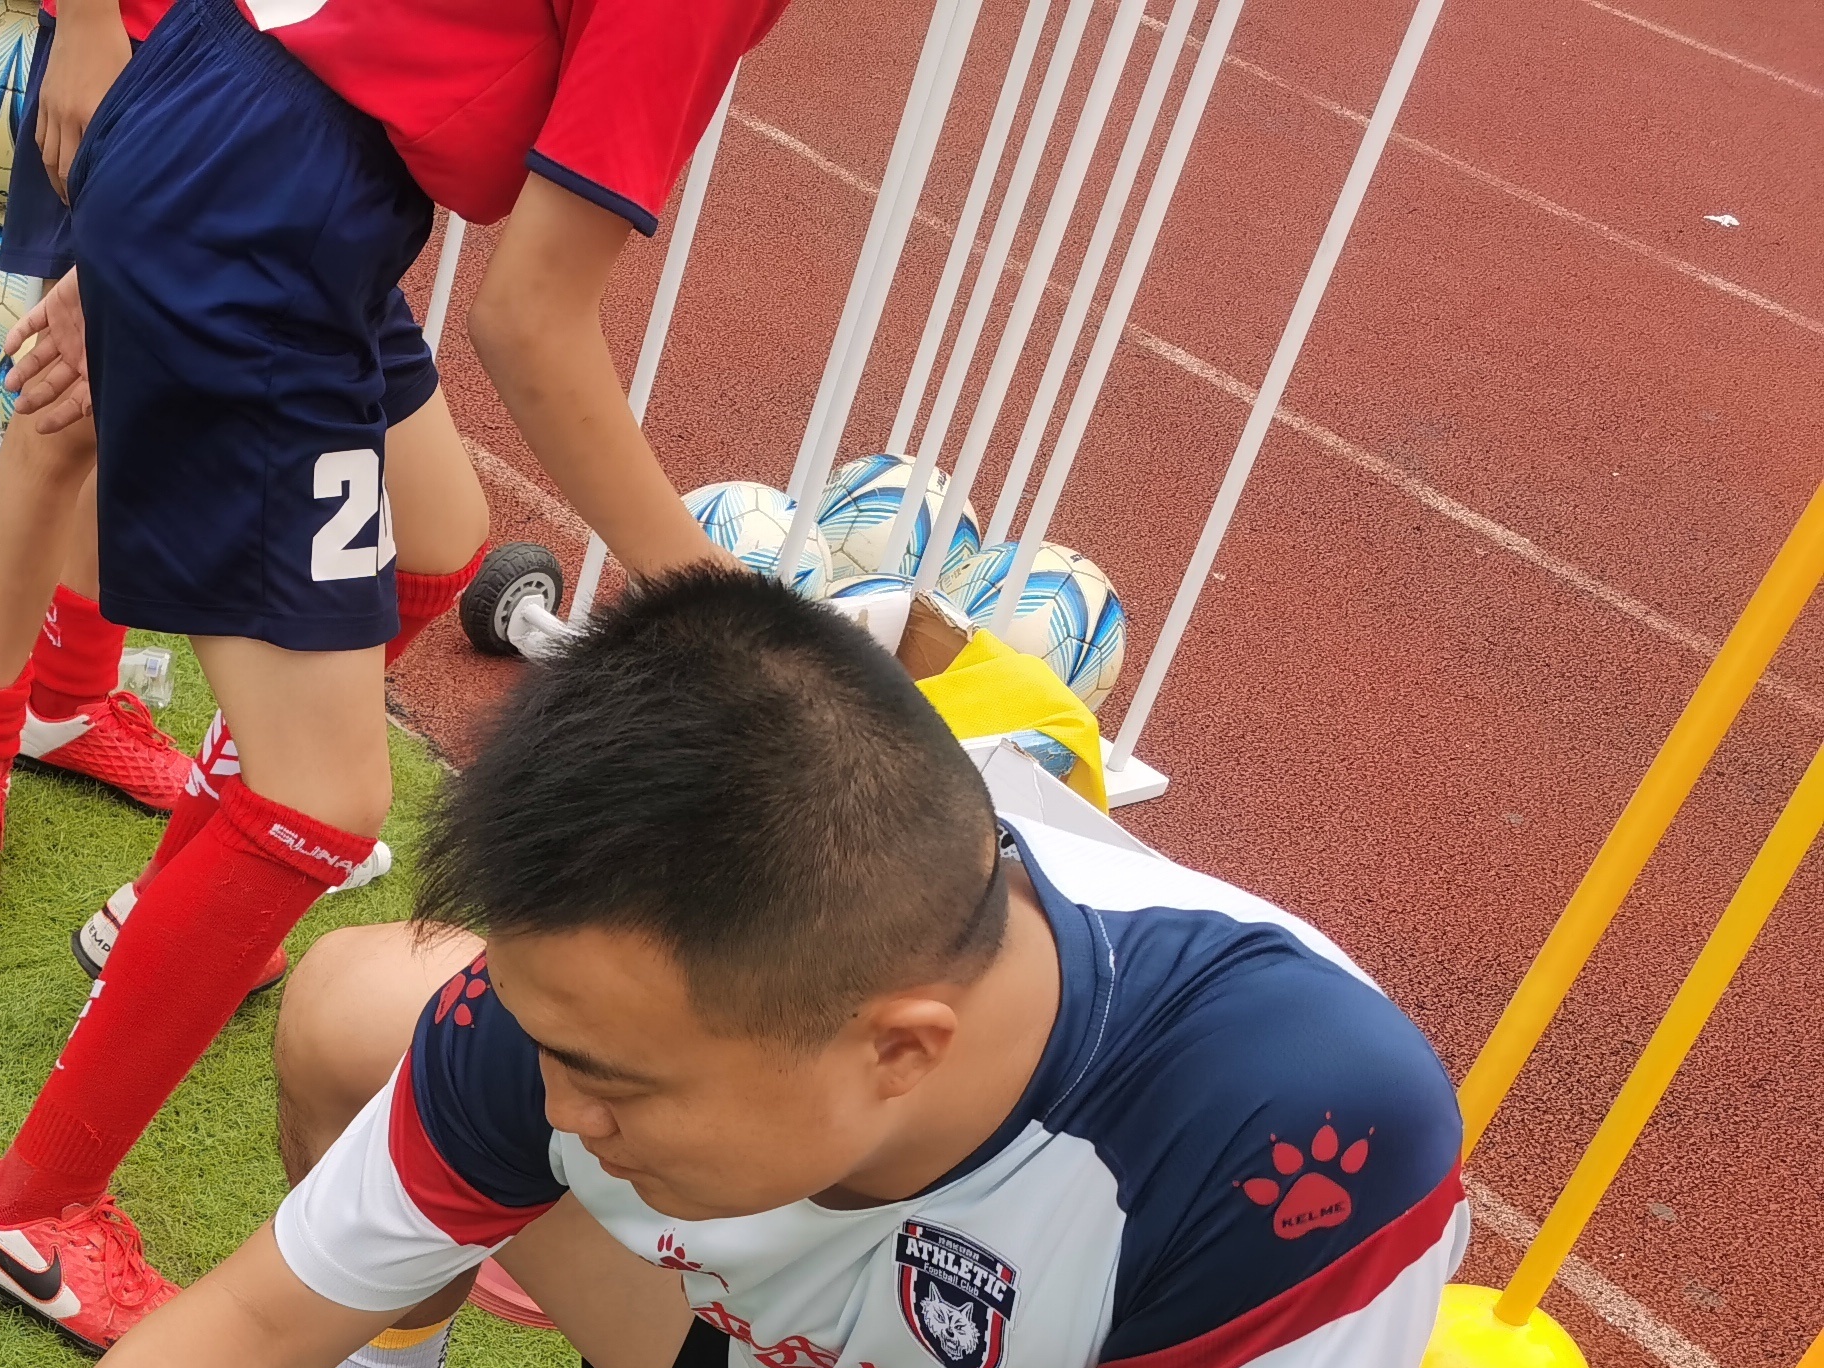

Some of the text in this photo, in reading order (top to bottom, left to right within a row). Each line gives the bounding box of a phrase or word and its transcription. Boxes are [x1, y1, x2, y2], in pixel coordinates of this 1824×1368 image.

[1281, 1201, 1348, 1229] KELME
[905, 1237, 1008, 1302] ATHLETIC
[924, 1262, 980, 1297] Football Club
